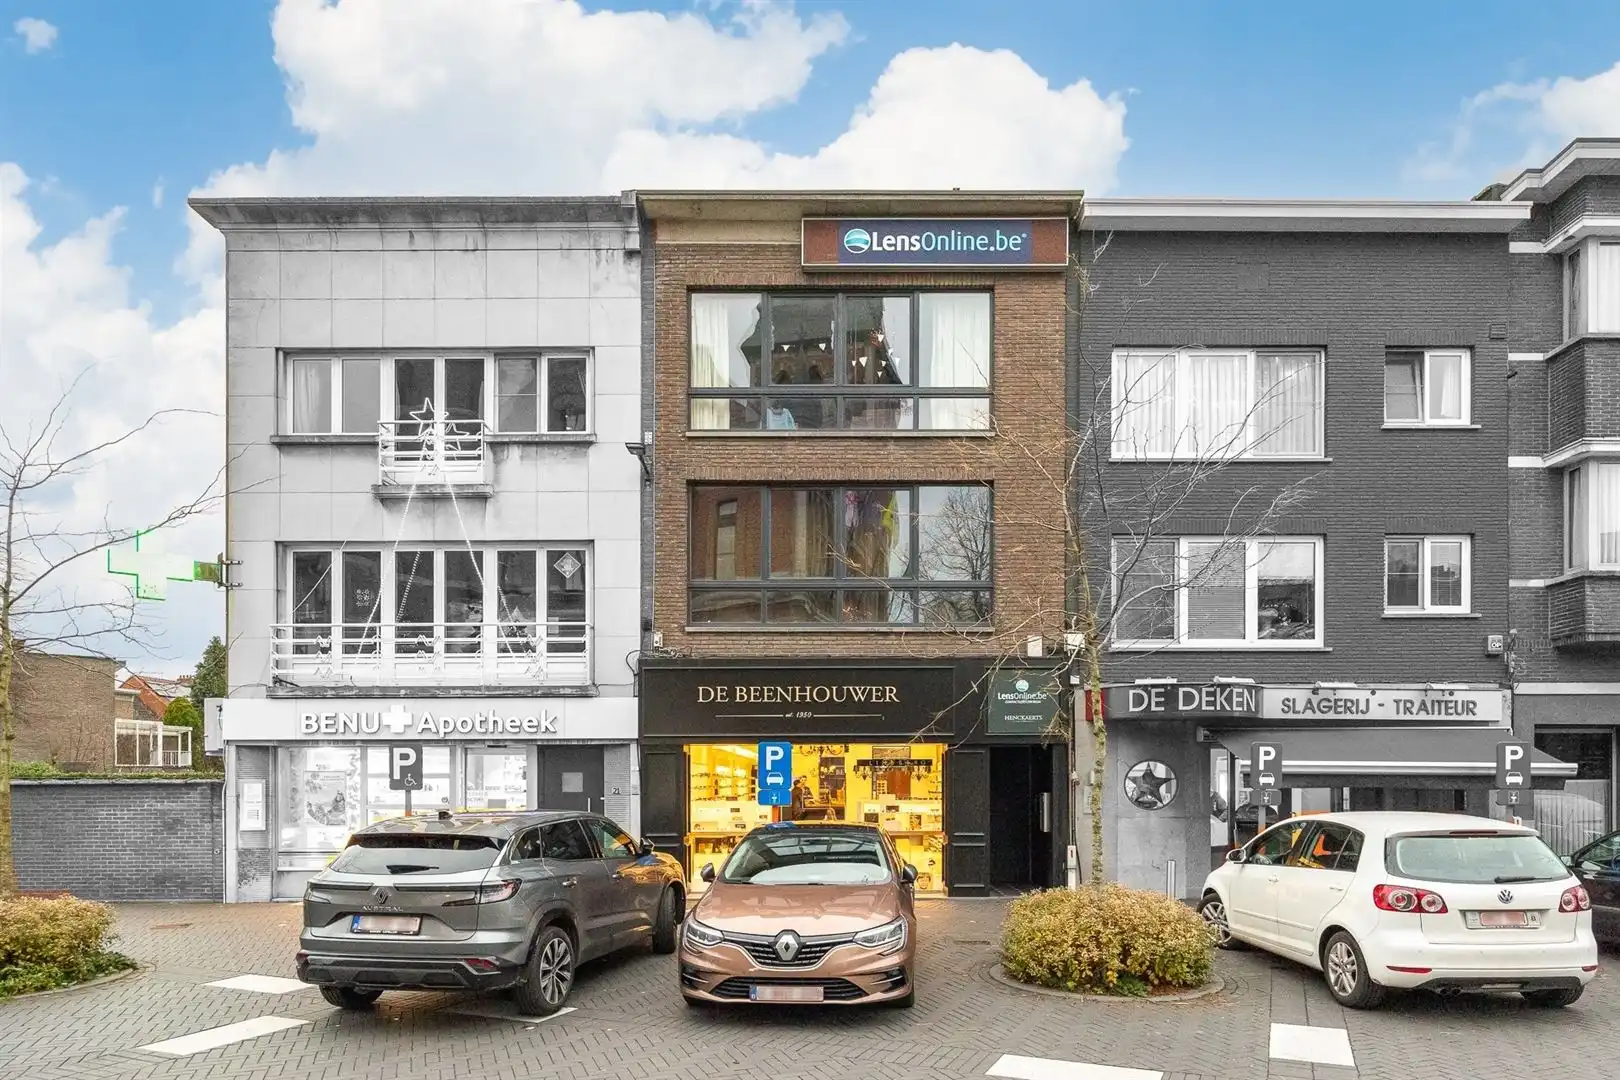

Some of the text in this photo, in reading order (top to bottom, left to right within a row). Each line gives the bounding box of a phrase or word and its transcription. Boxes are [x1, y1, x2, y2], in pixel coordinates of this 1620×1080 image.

[697, 686, 900, 703] DE BEENHOUWER
[1128, 688, 1255, 712] DE DEKEN
[1281, 697, 1370, 716] SLAGERIJ
[1393, 698, 1477, 717] TRAITEUR
[301, 710, 558, 738] BENU Apotheek
[393, 747, 416, 780] P
[766, 746, 784, 770] P
[1259, 746, 1276, 770] P
[1505, 745, 1523, 770] P
